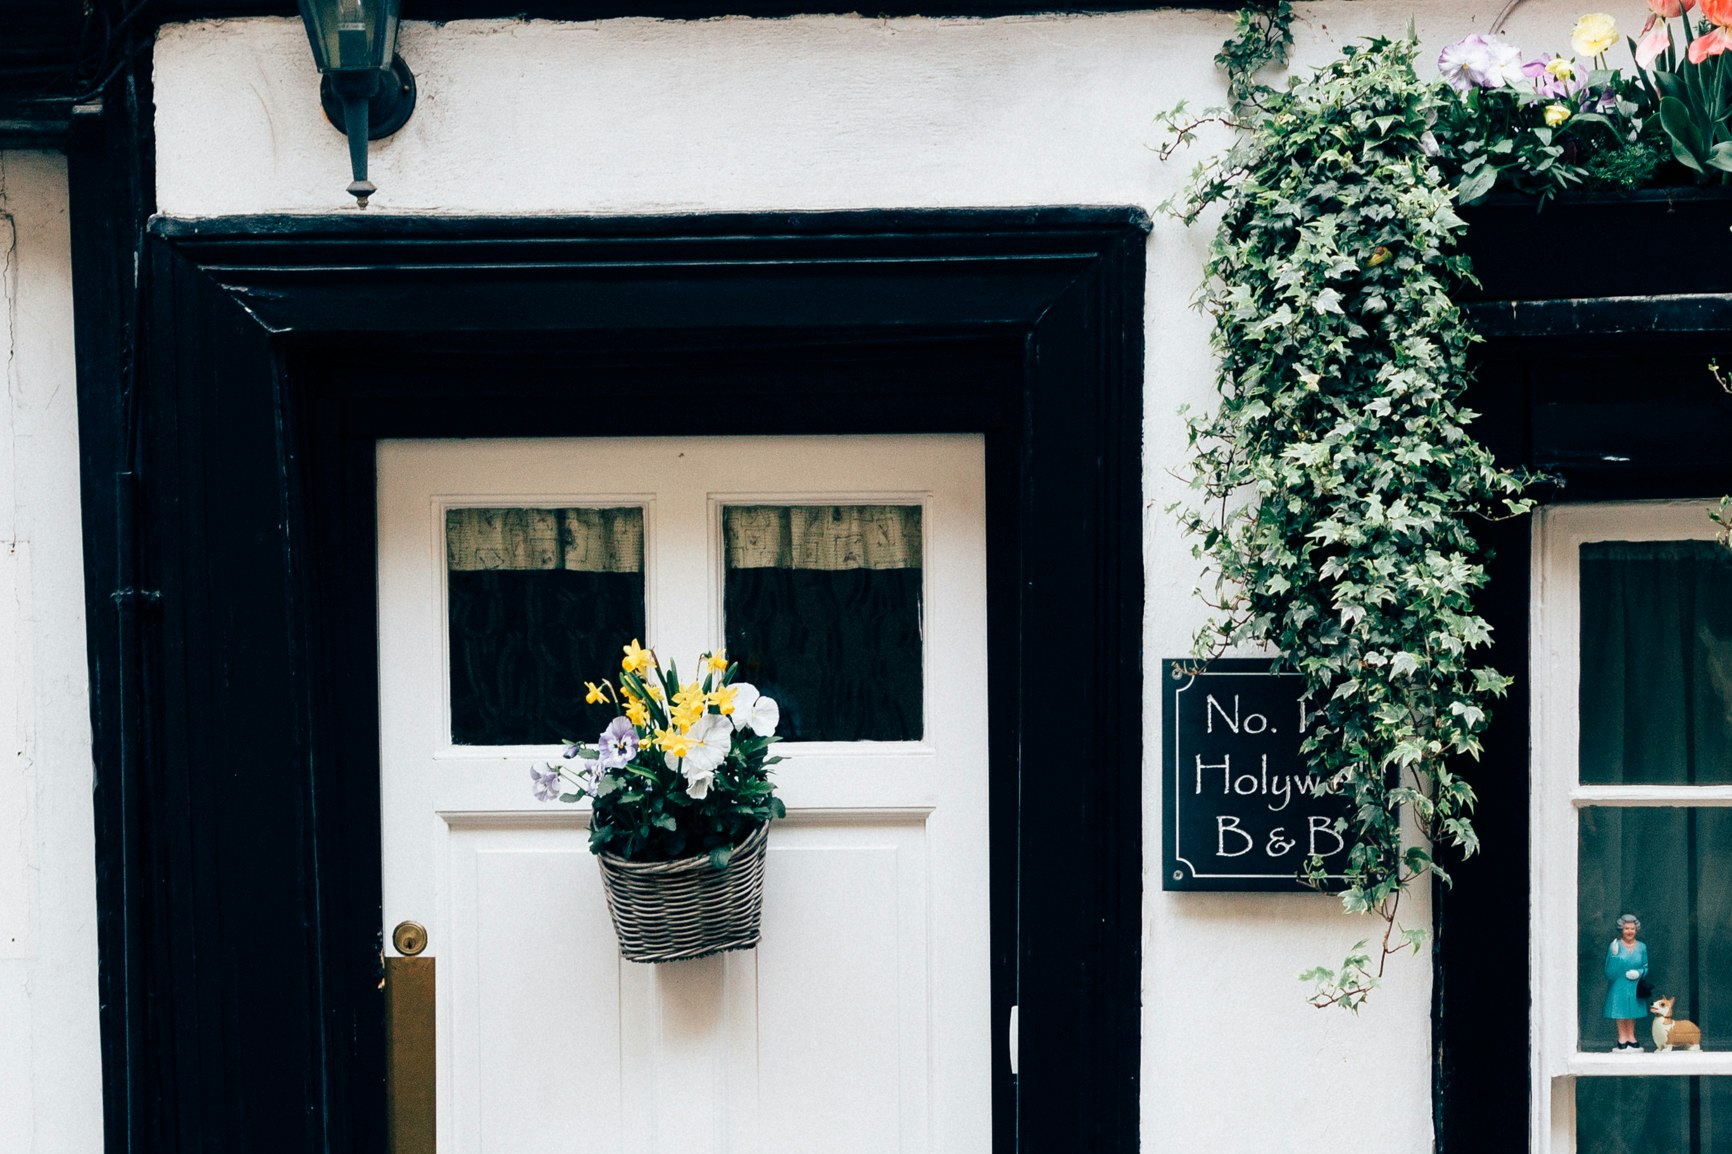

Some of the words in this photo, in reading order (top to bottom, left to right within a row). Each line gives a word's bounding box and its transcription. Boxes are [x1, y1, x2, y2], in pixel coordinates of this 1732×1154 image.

[1206, 694, 1278, 734] No.
[1215, 815, 1254, 858] B
[1265, 827, 1297, 858] &
[1306, 815, 1345, 858] B
